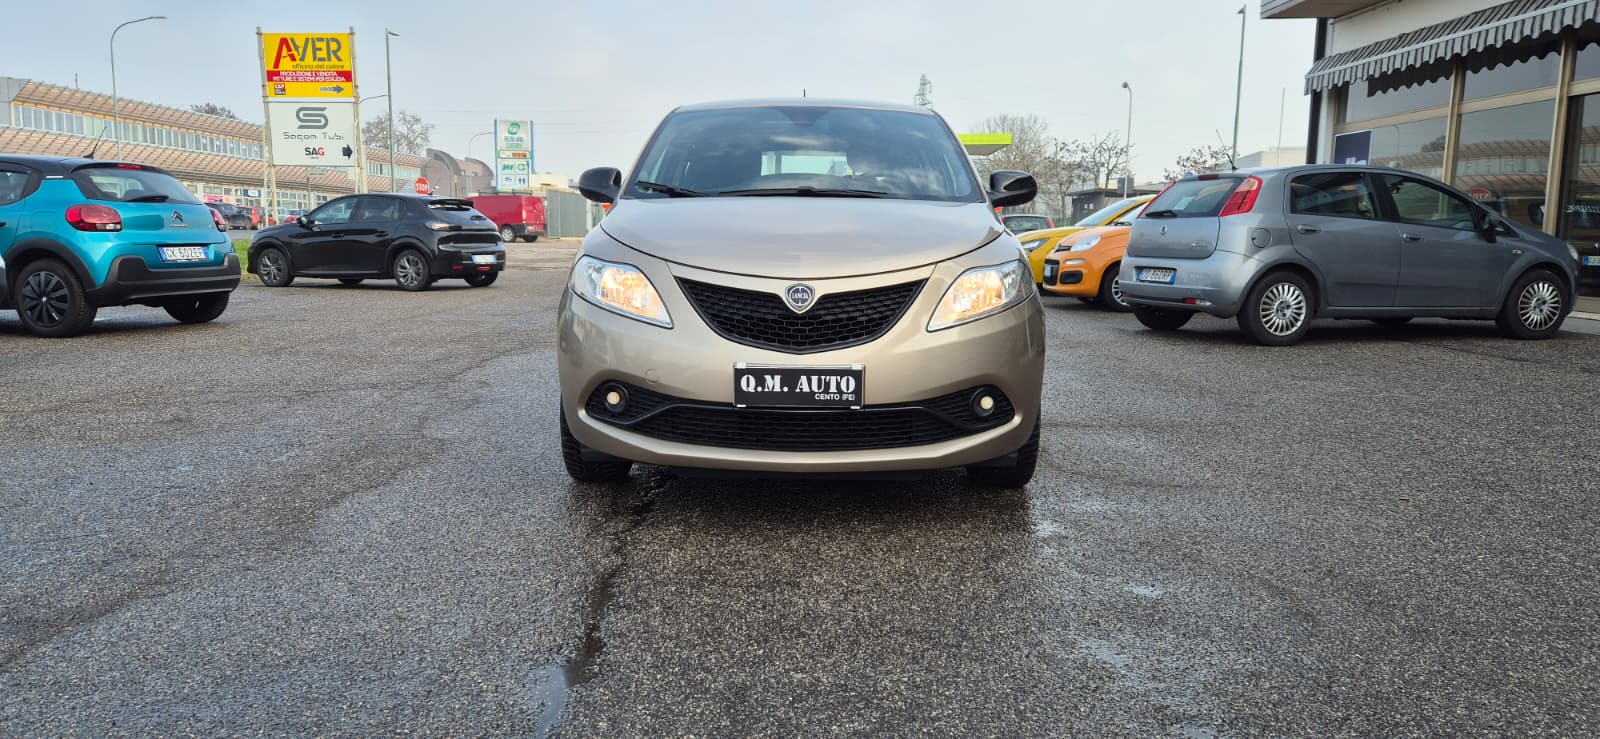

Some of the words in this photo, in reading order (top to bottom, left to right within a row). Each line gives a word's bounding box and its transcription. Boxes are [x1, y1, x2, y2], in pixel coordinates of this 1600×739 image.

[273, 37, 343, 69] AVER
[304, 147, 325, 156] SAG
[415, 183, 429, 192] STOP
[740, 374, 789, 392] Q.M.
[795, 375, 856, 393] AUTO
[842, 393, 856, 401] (FE)
